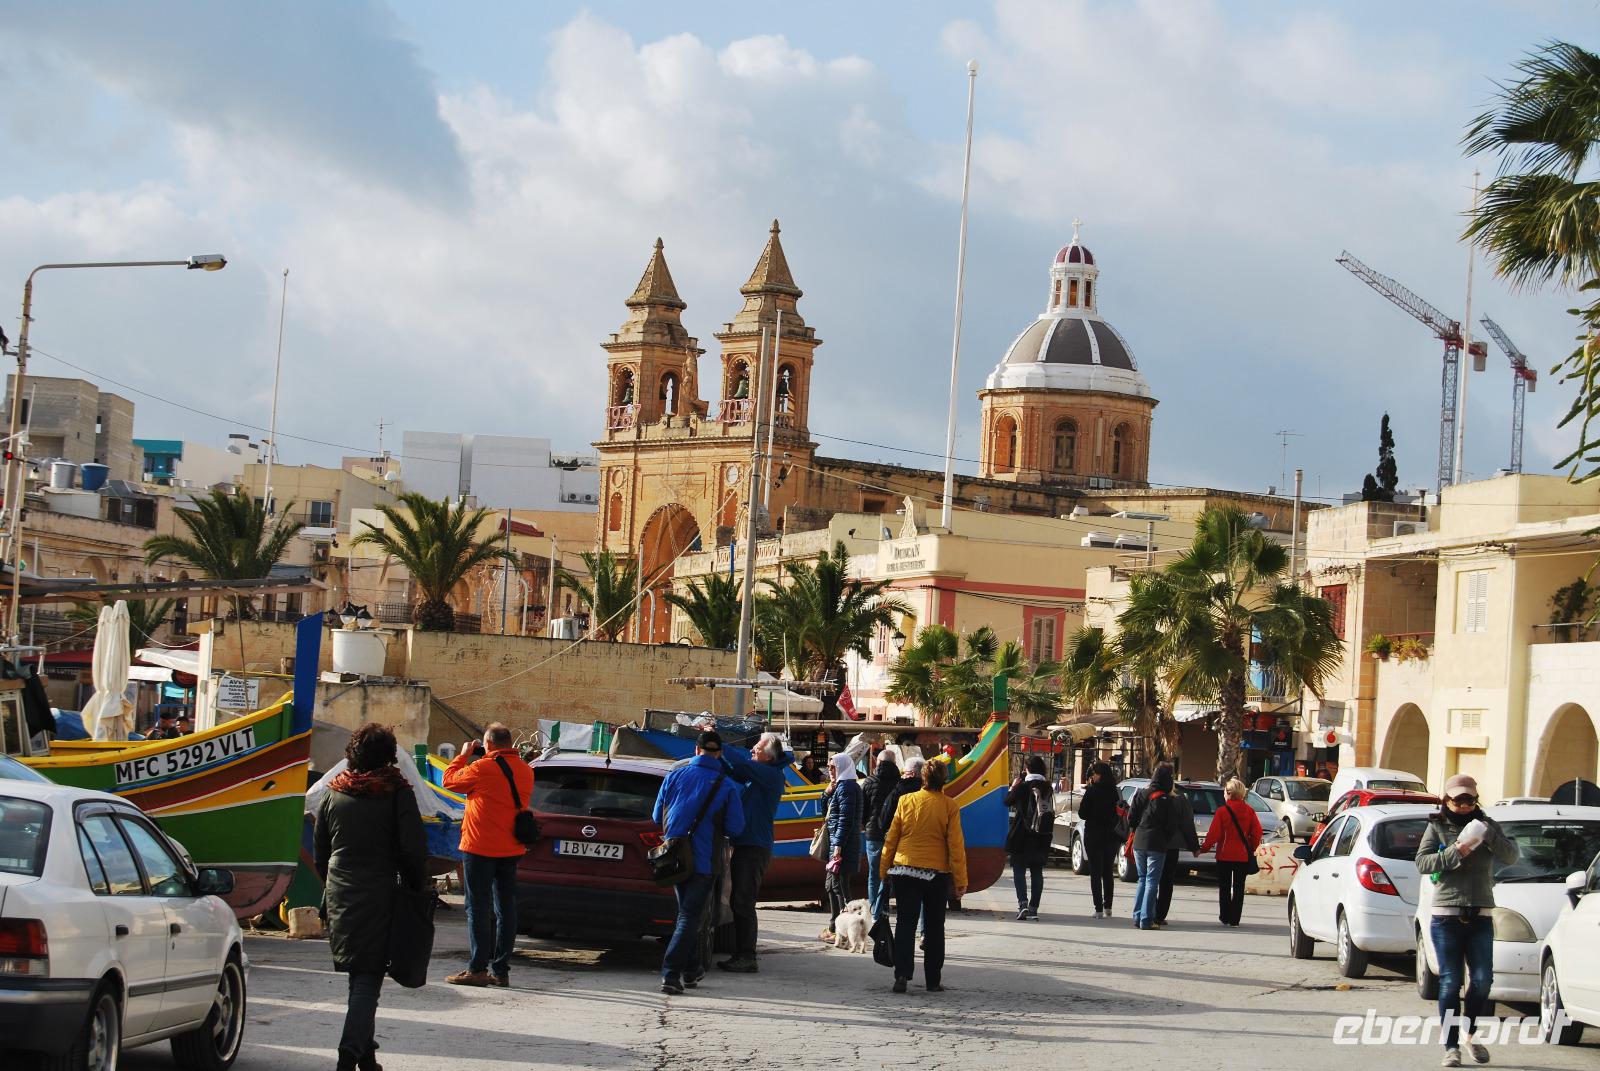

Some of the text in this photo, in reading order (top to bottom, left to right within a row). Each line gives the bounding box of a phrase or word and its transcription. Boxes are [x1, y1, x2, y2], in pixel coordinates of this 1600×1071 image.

[716, 397, 756, 426] 2017
[115, 728, 253, 783] MFC 5292 VLT
